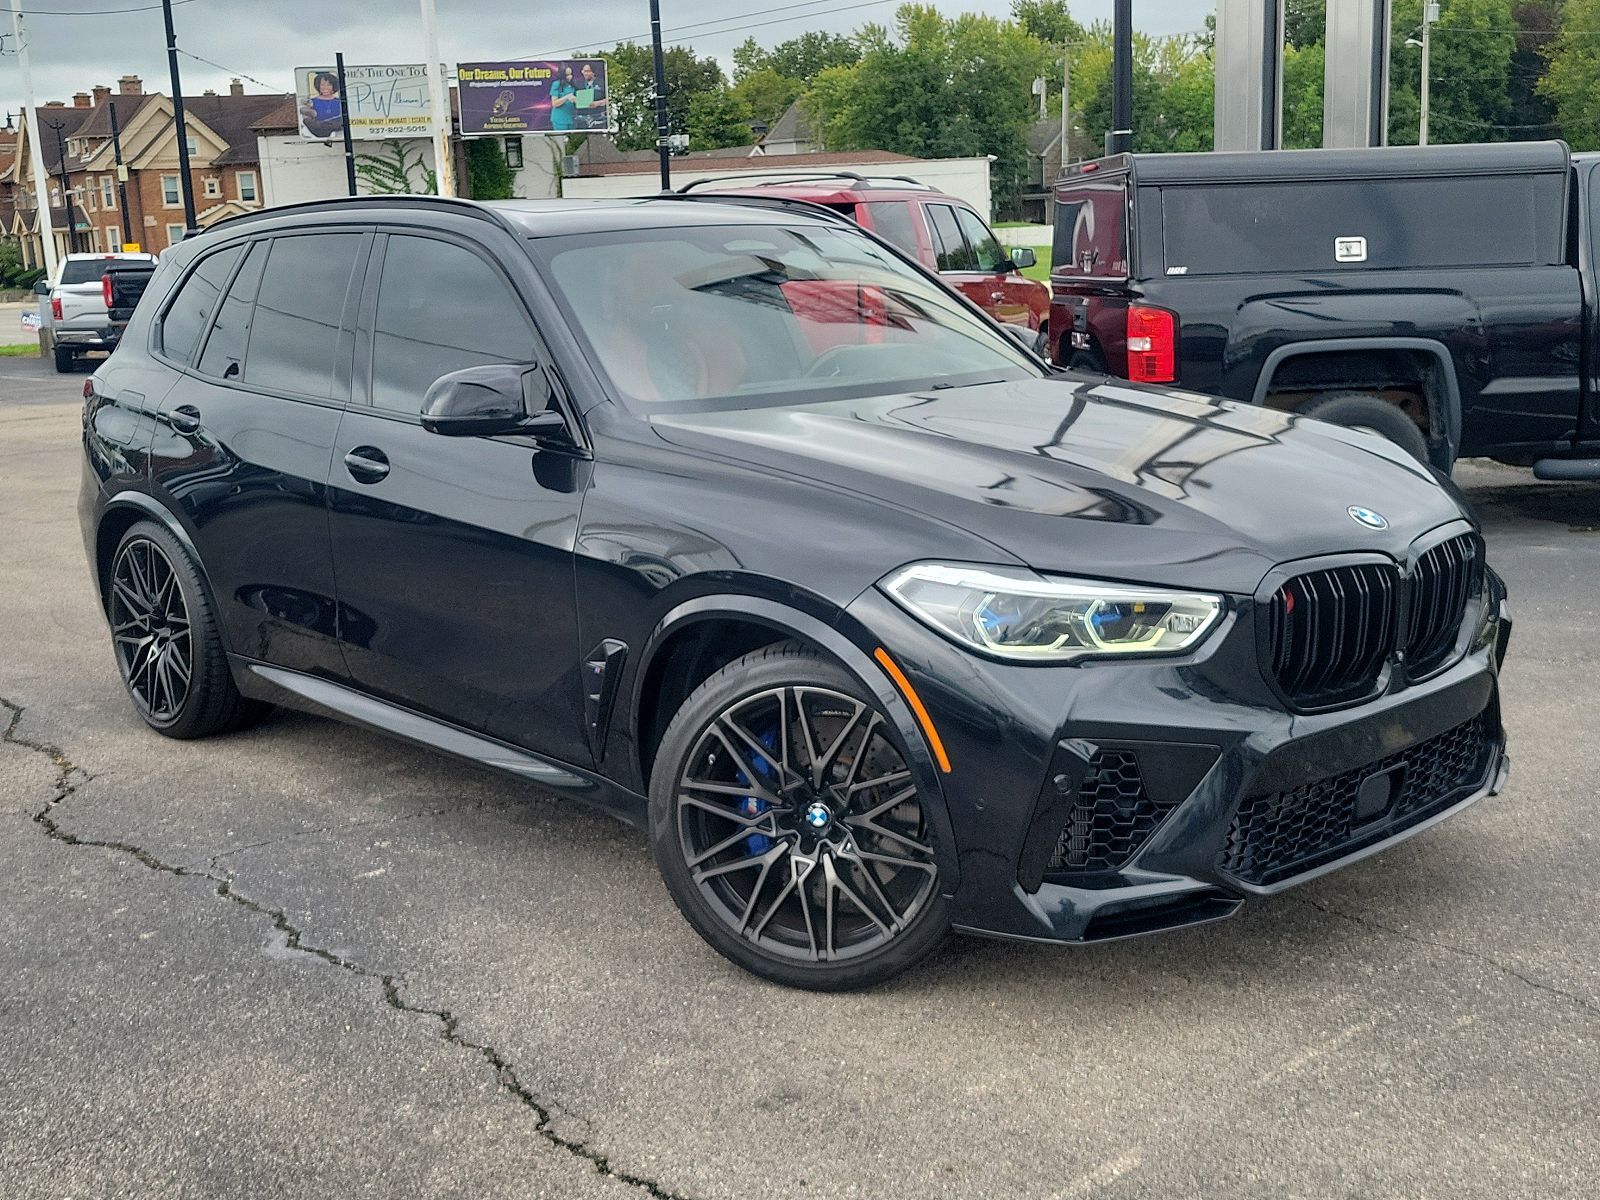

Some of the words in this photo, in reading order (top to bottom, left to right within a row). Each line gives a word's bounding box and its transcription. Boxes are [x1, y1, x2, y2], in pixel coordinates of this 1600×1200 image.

[345, 69, 364, 79] HE'S
[385, 67, 406, 78] ONE
[459, 68, 474, 80] Our
[474, 68, 508, 81] Dreams,
[508, 67, 523, 79] Our
[523, 67, 551, 80] Future
[369, 125, 427, 134] 937-802-5015
